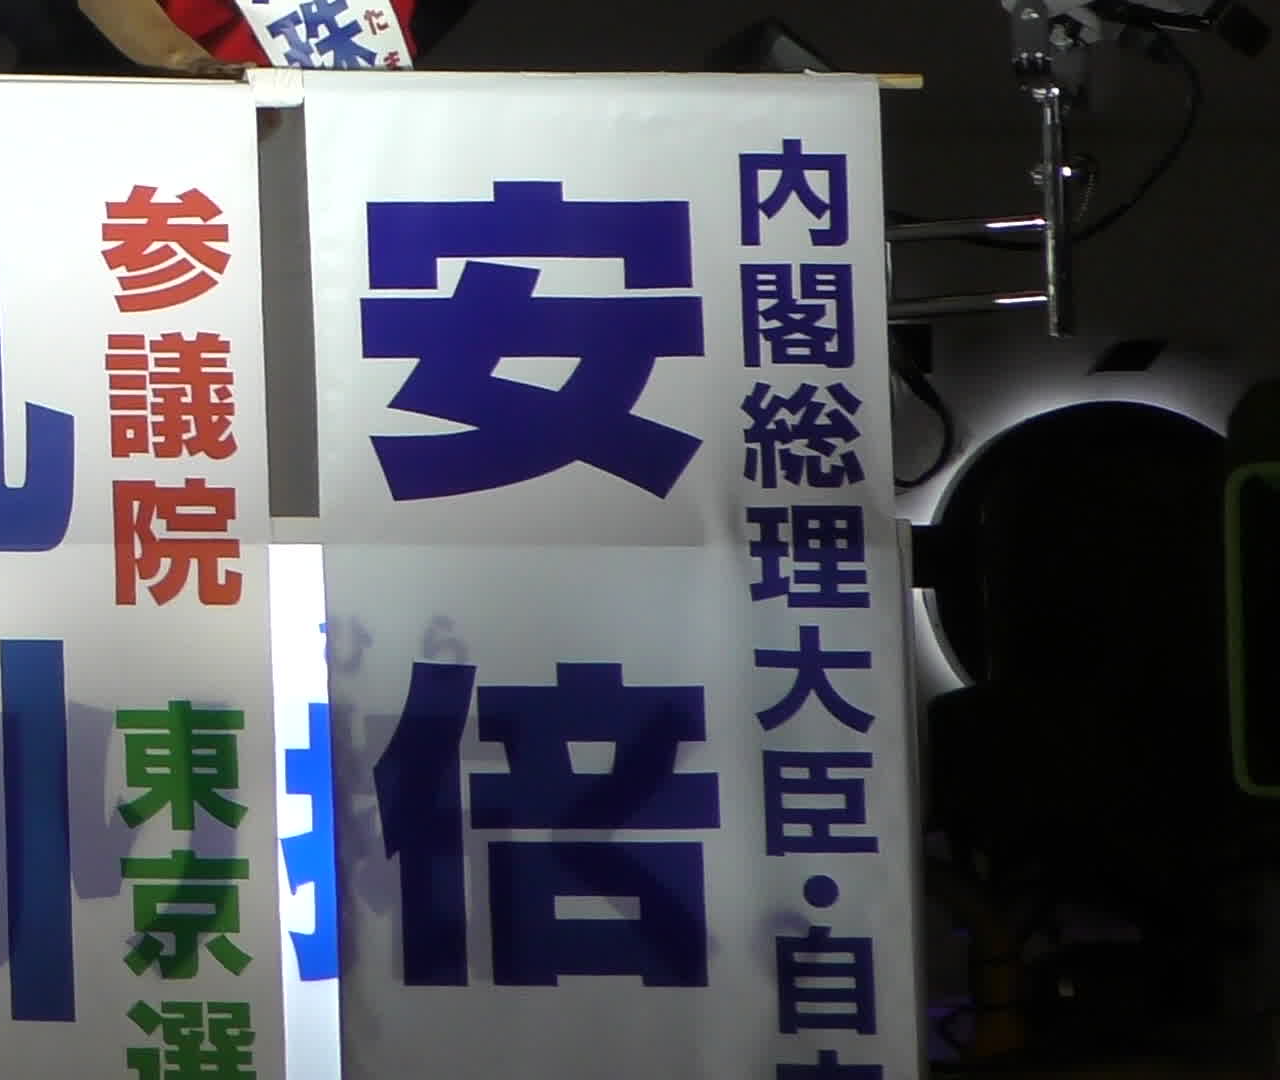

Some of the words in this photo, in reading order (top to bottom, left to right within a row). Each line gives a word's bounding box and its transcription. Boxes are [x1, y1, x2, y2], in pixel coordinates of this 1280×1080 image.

[101, 184, 243, 608] 参議院
[359, 181, 721, 987] 安倍
[115, 699, 258, 1080] 東京選
